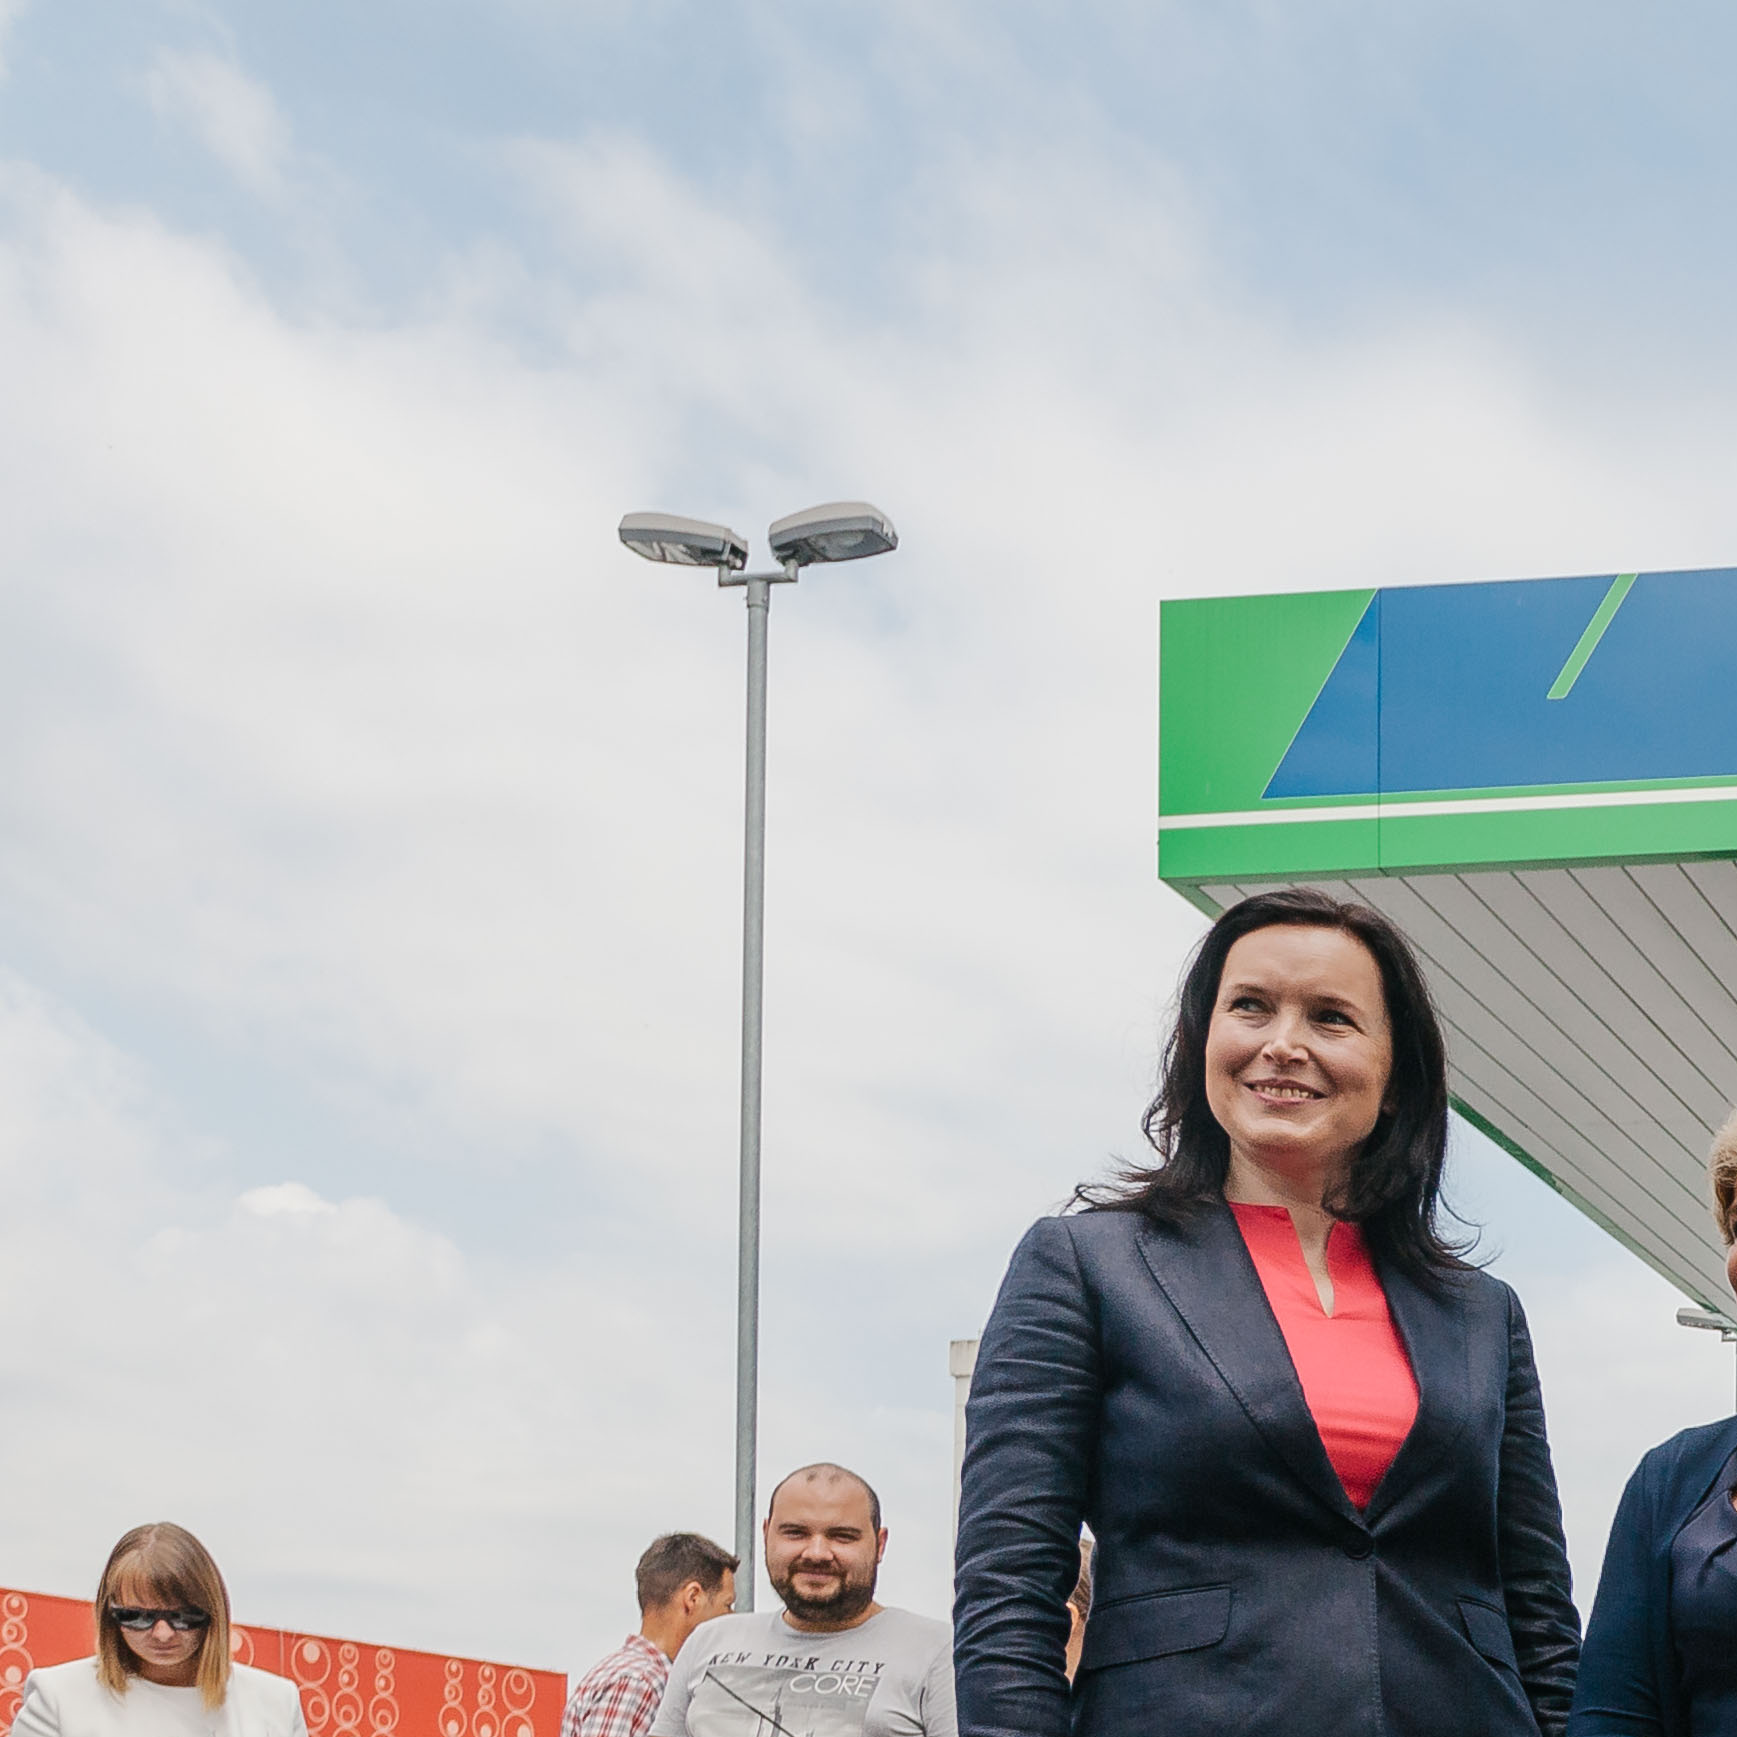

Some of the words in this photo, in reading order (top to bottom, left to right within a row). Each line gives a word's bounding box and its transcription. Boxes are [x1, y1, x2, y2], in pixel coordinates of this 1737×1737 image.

[762, 1653, 820, 1671] YORK
[830, 1659, 885, 1675] CITY
[789, 1673, 875, 1698] CORE
